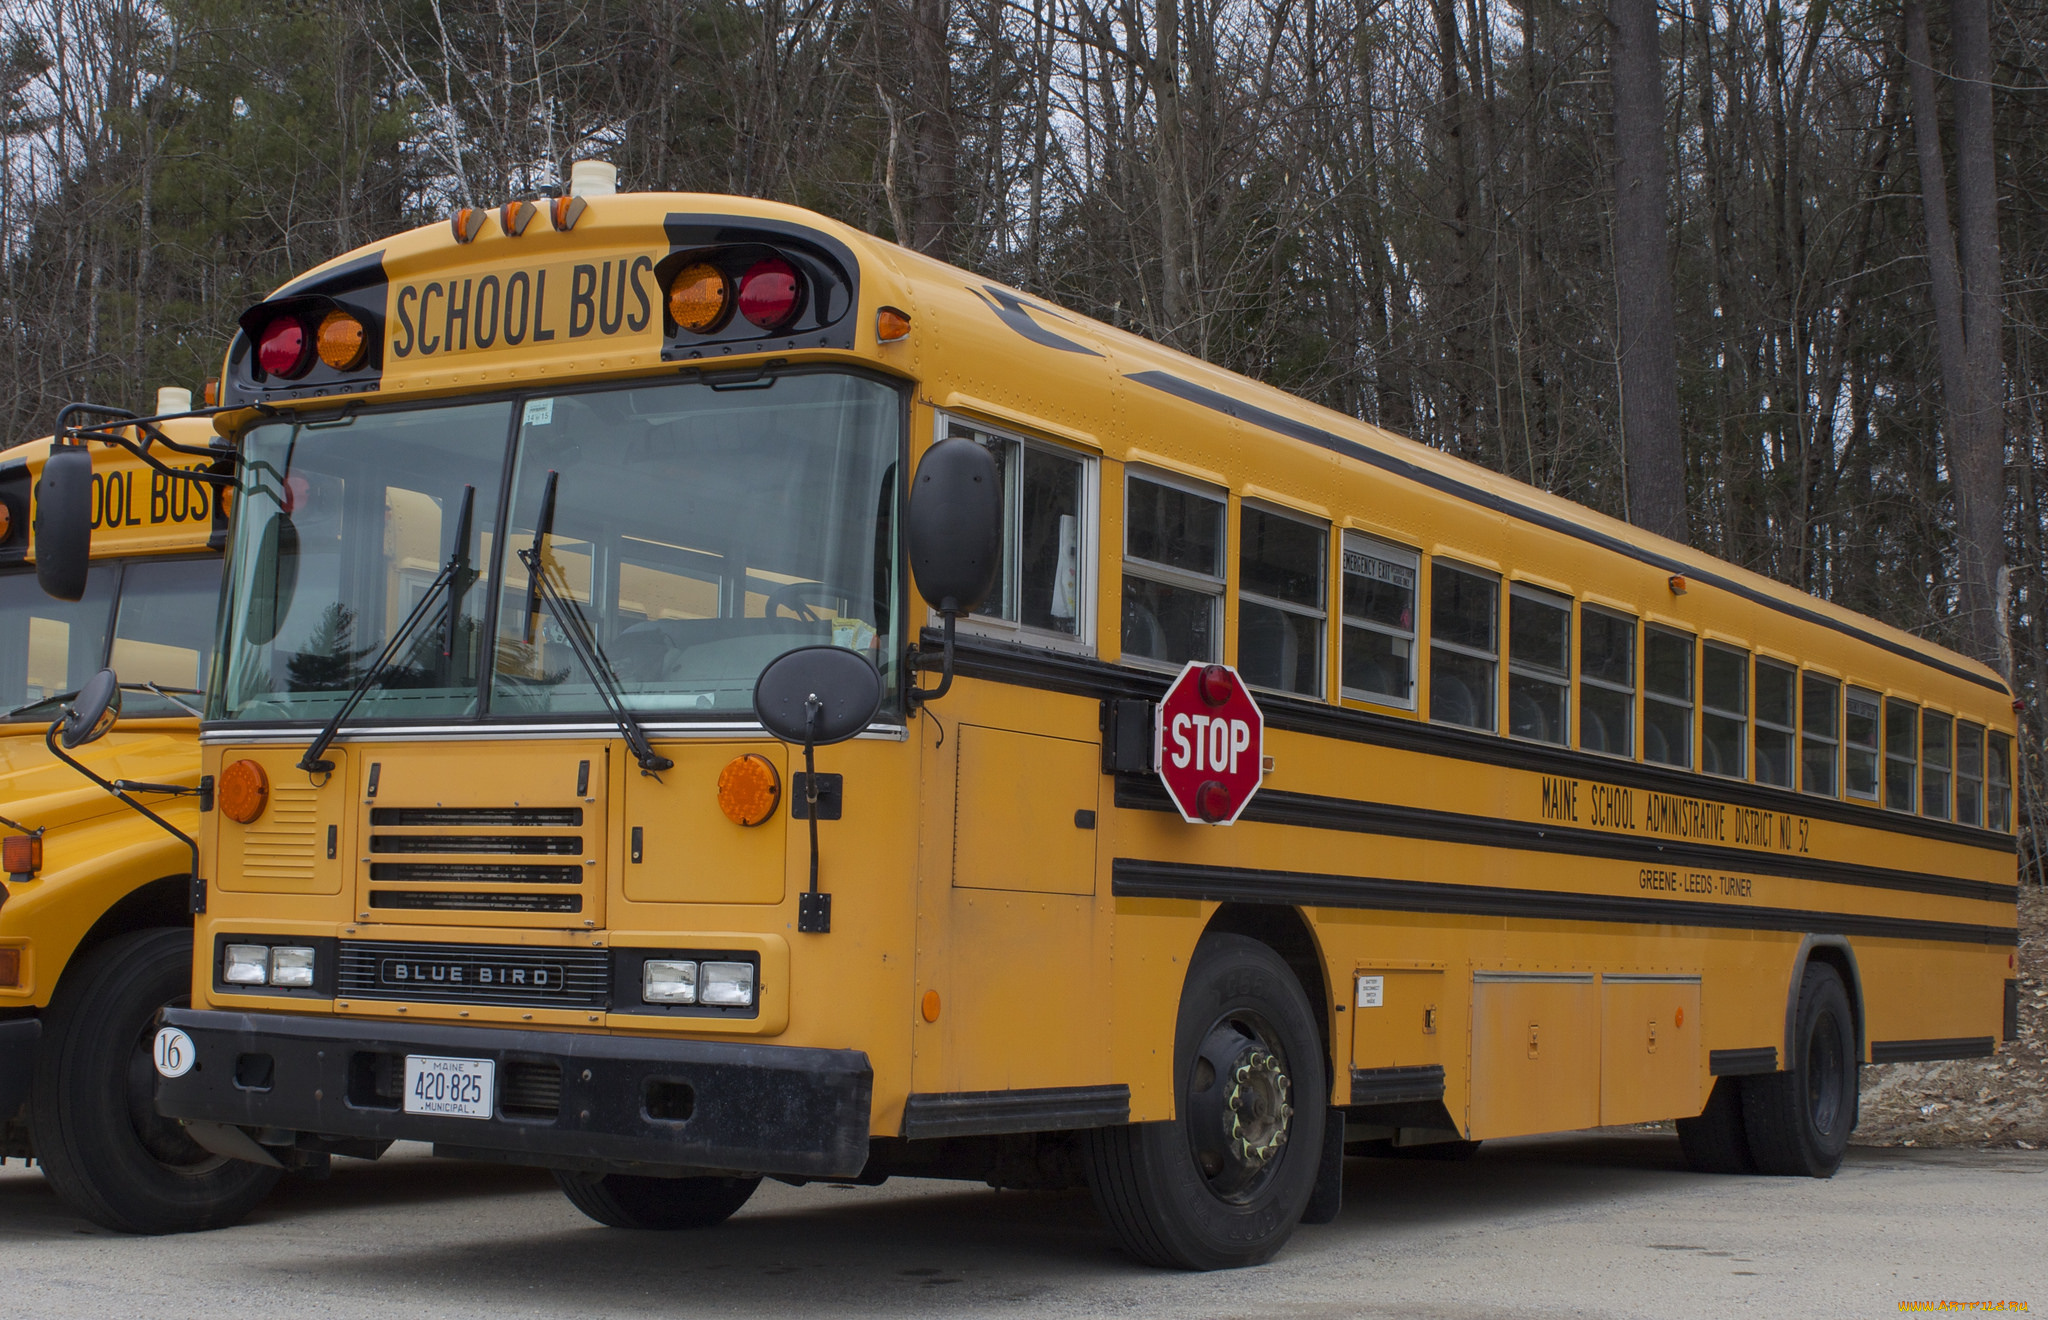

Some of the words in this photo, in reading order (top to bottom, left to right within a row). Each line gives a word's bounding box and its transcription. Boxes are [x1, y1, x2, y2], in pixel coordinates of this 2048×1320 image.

[394, 269, 555, 358] SCHOOL
[569, 255, 653, 338] BUS
[151, 463, 209, 523] BUS
[1343, 552, 1376, 577] EMERGENCY
[1379, 561, 1391, 580] EXIT
[1171, 713, 1250, 774] STOP
[1542, 776, 1578, 822] MAINE
[1591, 784, 1635, 829] SCHOOL
[1646, 793, 1725, 841] ADMINISTRATIVE
[1736, 807, 1773, 848] DISTRICT
[1799, 819, 1809, 853] 52
[1639, 869, 1677, 891] GREENE
[1684, 873, 1713, 894] LEEDS
[1720, 876, 1752, 898] TURNER
[395, 964, 463, 982] BLUE
[479, 967, 549, 985] BIRD
[160, 1034, 183, 1070] 16
[433, 1062, 465, 1072] MAINE
[425, 1102, 469, 1114] MUNICIPAL
